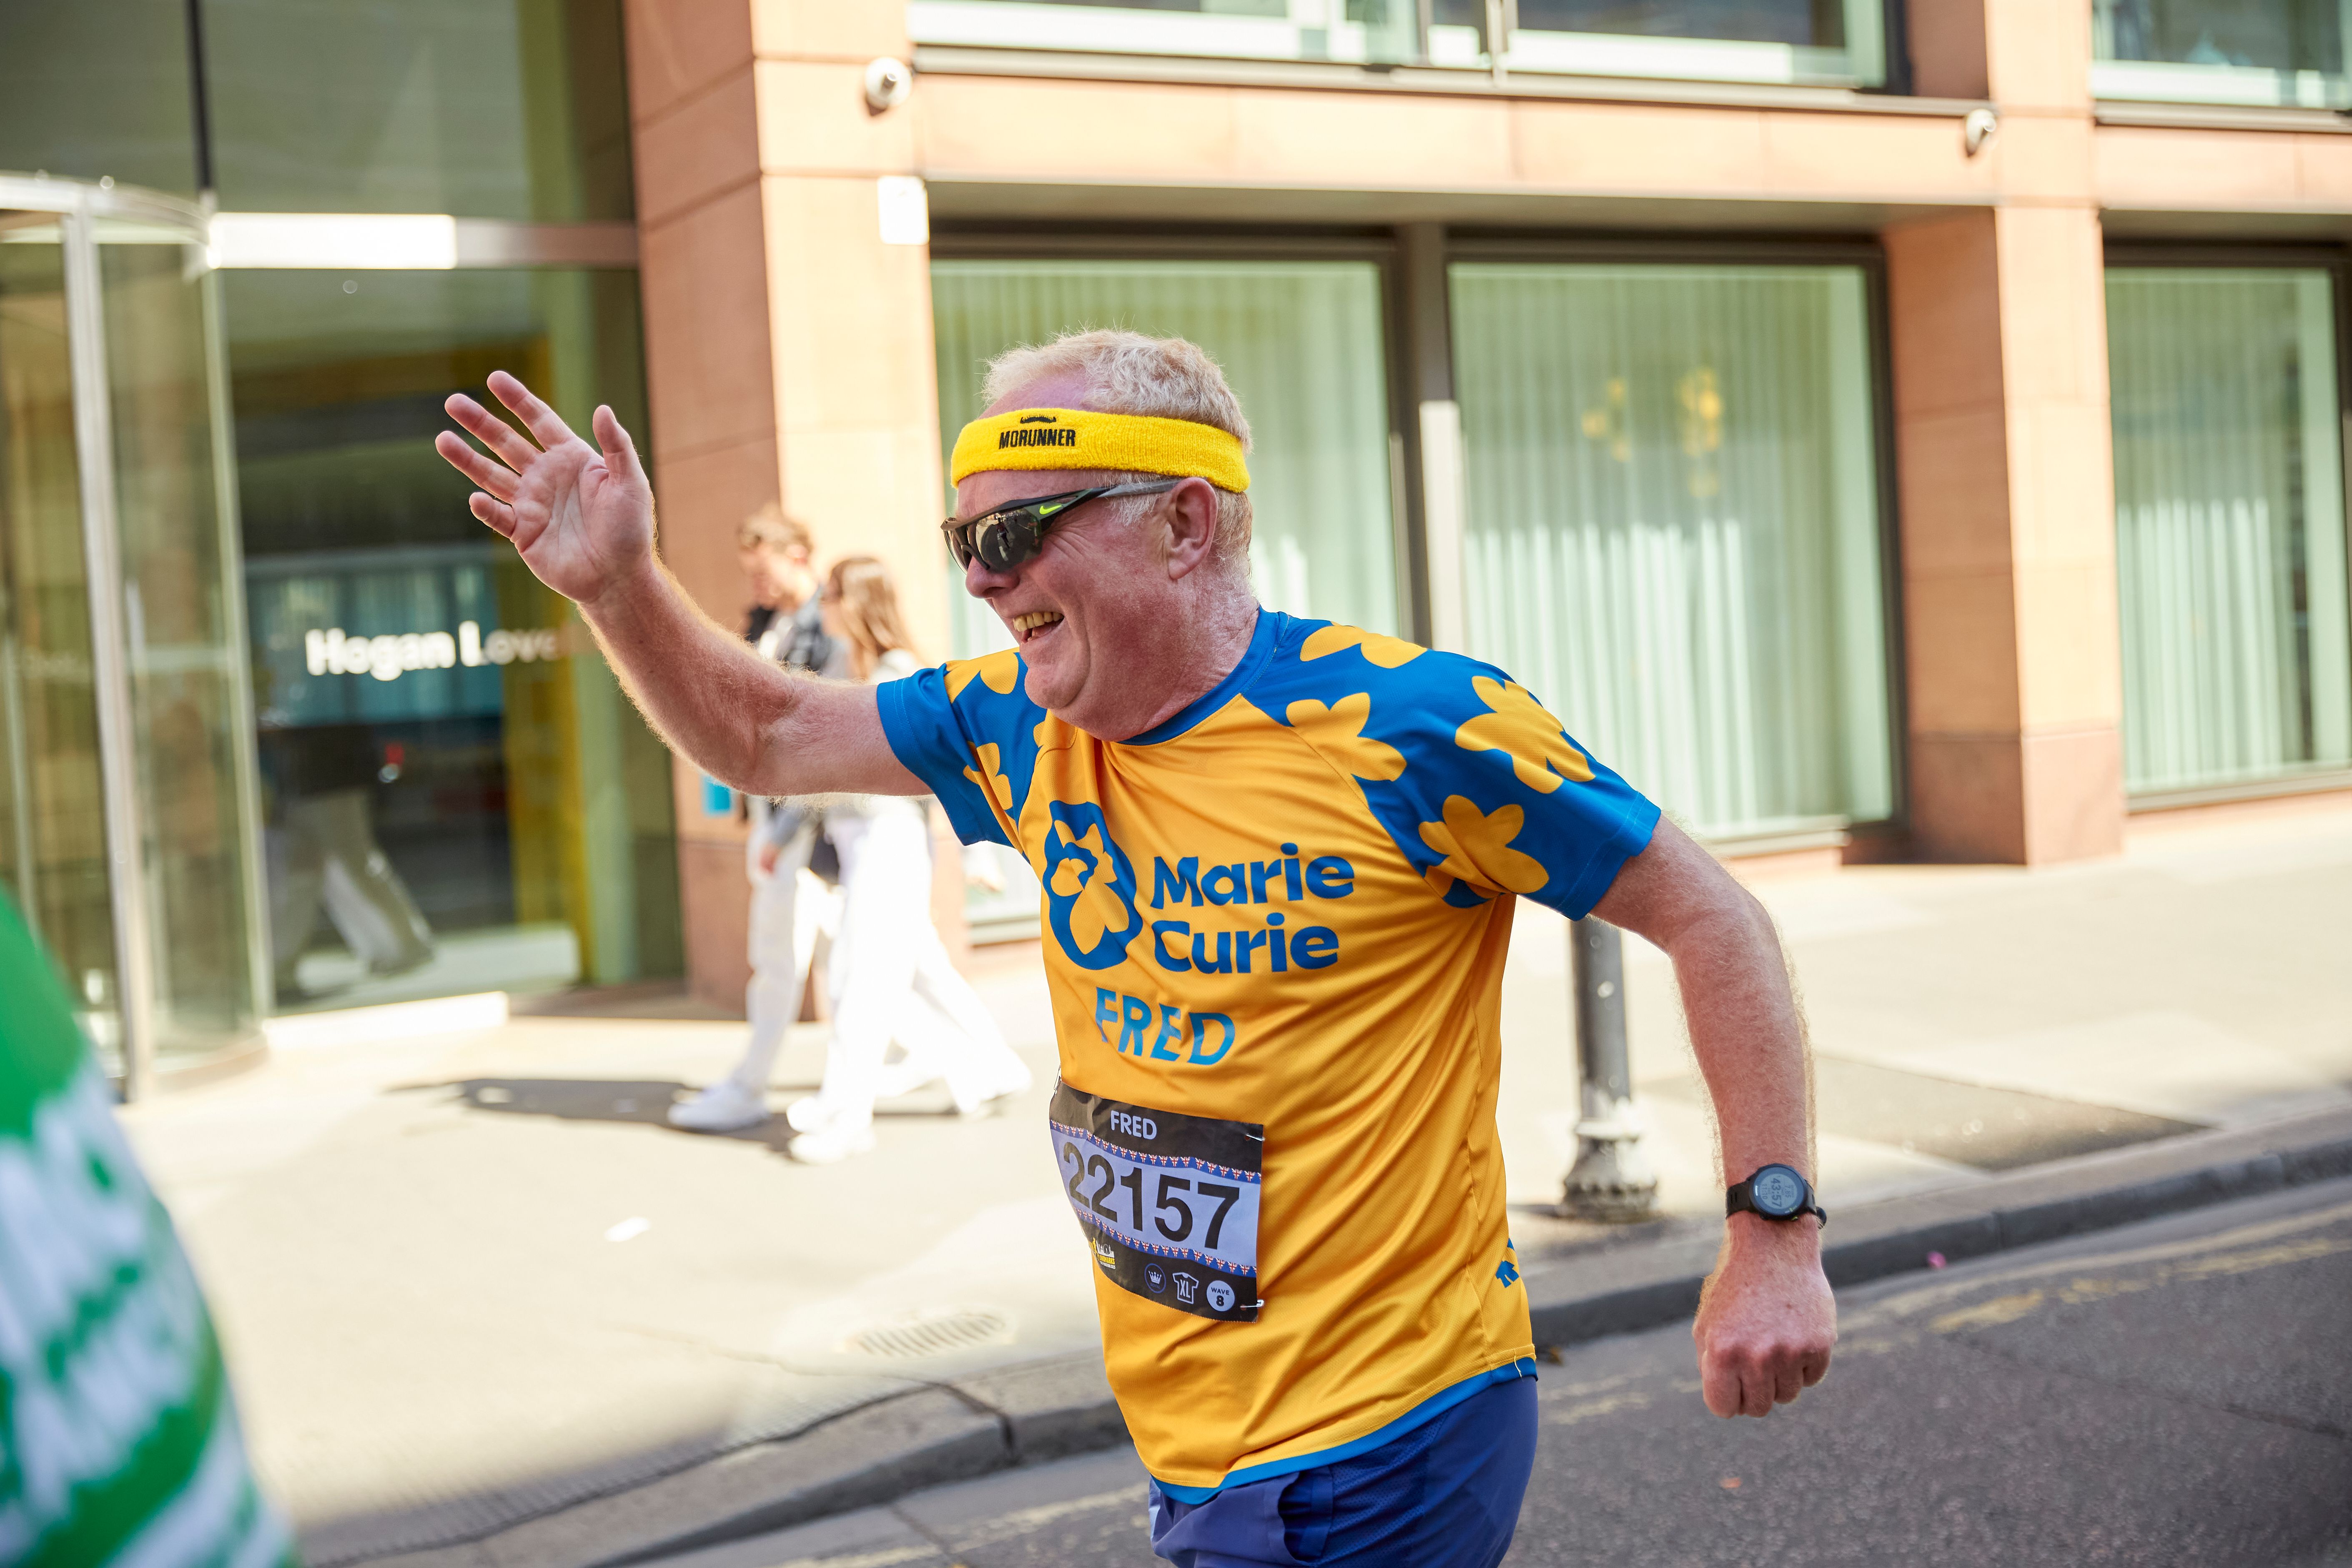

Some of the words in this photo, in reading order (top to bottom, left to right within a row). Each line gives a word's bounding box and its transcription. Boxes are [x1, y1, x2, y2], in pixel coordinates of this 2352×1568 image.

[999, 429, 1076, 449] MORUNNER
[305, 627, 456, 681] Hogan
[1150, 843, 1355, 909] Marie
[1152, 913, 1339, 974] Curie
[1095, 986, 1235, 1065] FRED
[1111, 1110, 1157, 1140] FRED
[1063, 1142, 1240, 1250] 22157
[1180, 1279, 1190, 1298] XL
[1211, 1287, 1229, 1295] WAVE
[1216, 1295, 1224, 1307] 8
